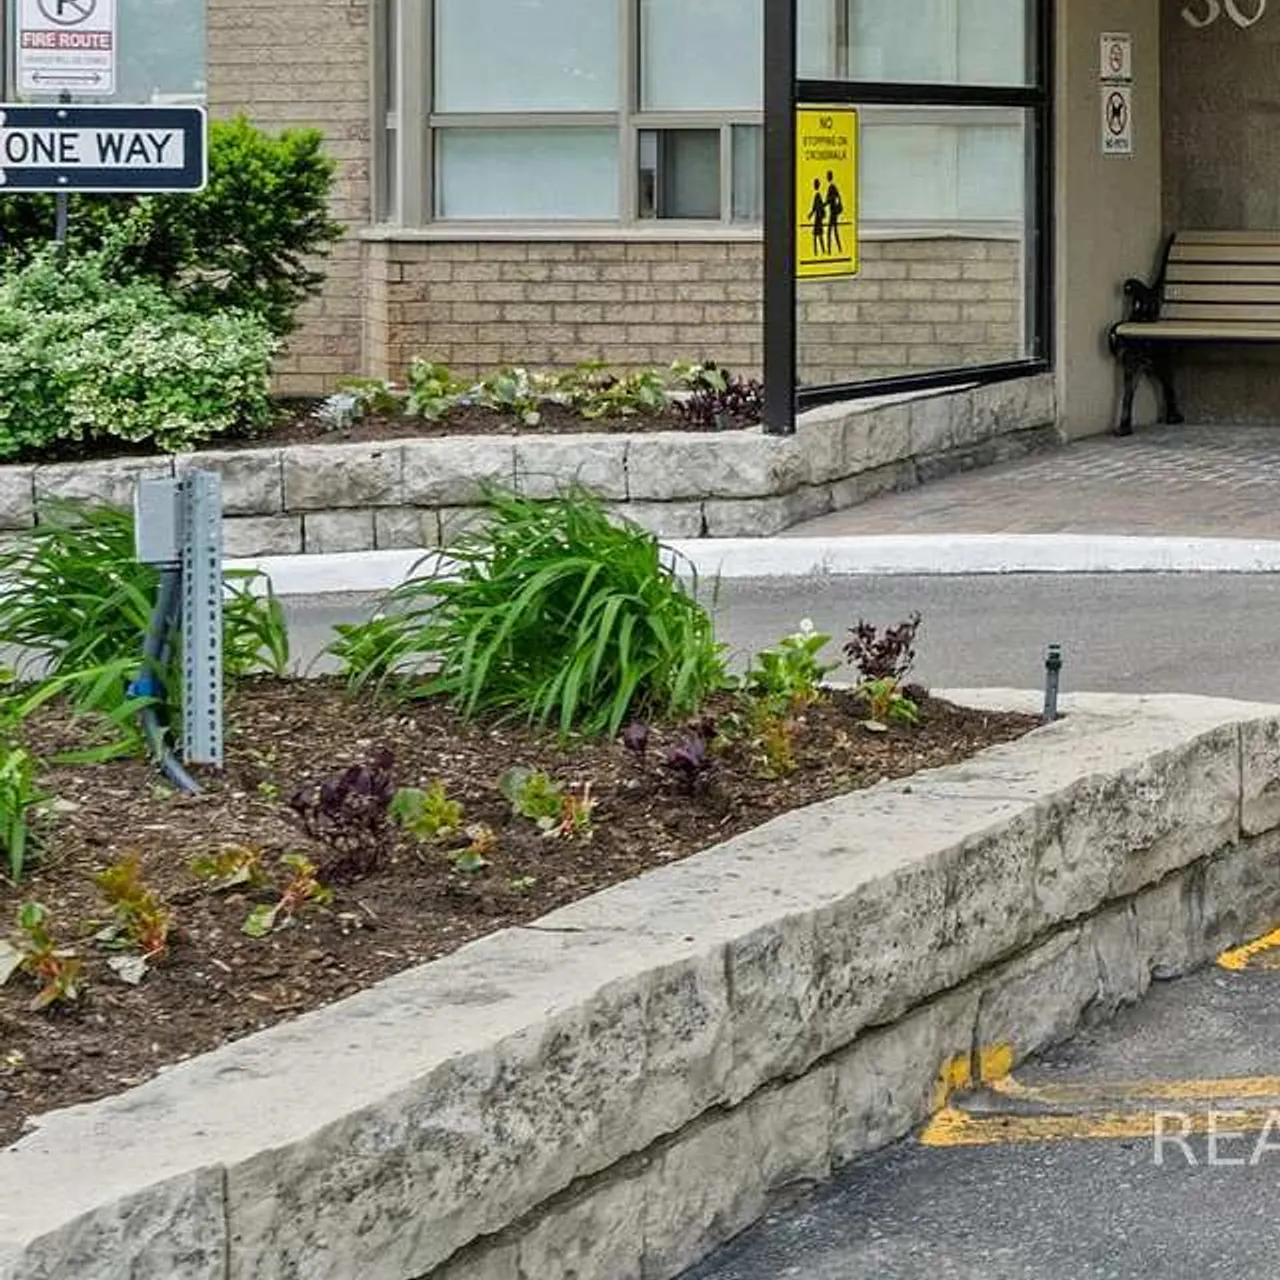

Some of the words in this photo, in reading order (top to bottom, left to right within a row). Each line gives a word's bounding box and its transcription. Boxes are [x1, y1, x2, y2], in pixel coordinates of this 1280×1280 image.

[22, 31, 57, 48] FIRE
[59, 32, 111, 49] ROUTE
[819, 117, 834, 129] NO
[5, 132, 80, 164] ONE
[96, 132, 173, 164] WAY
